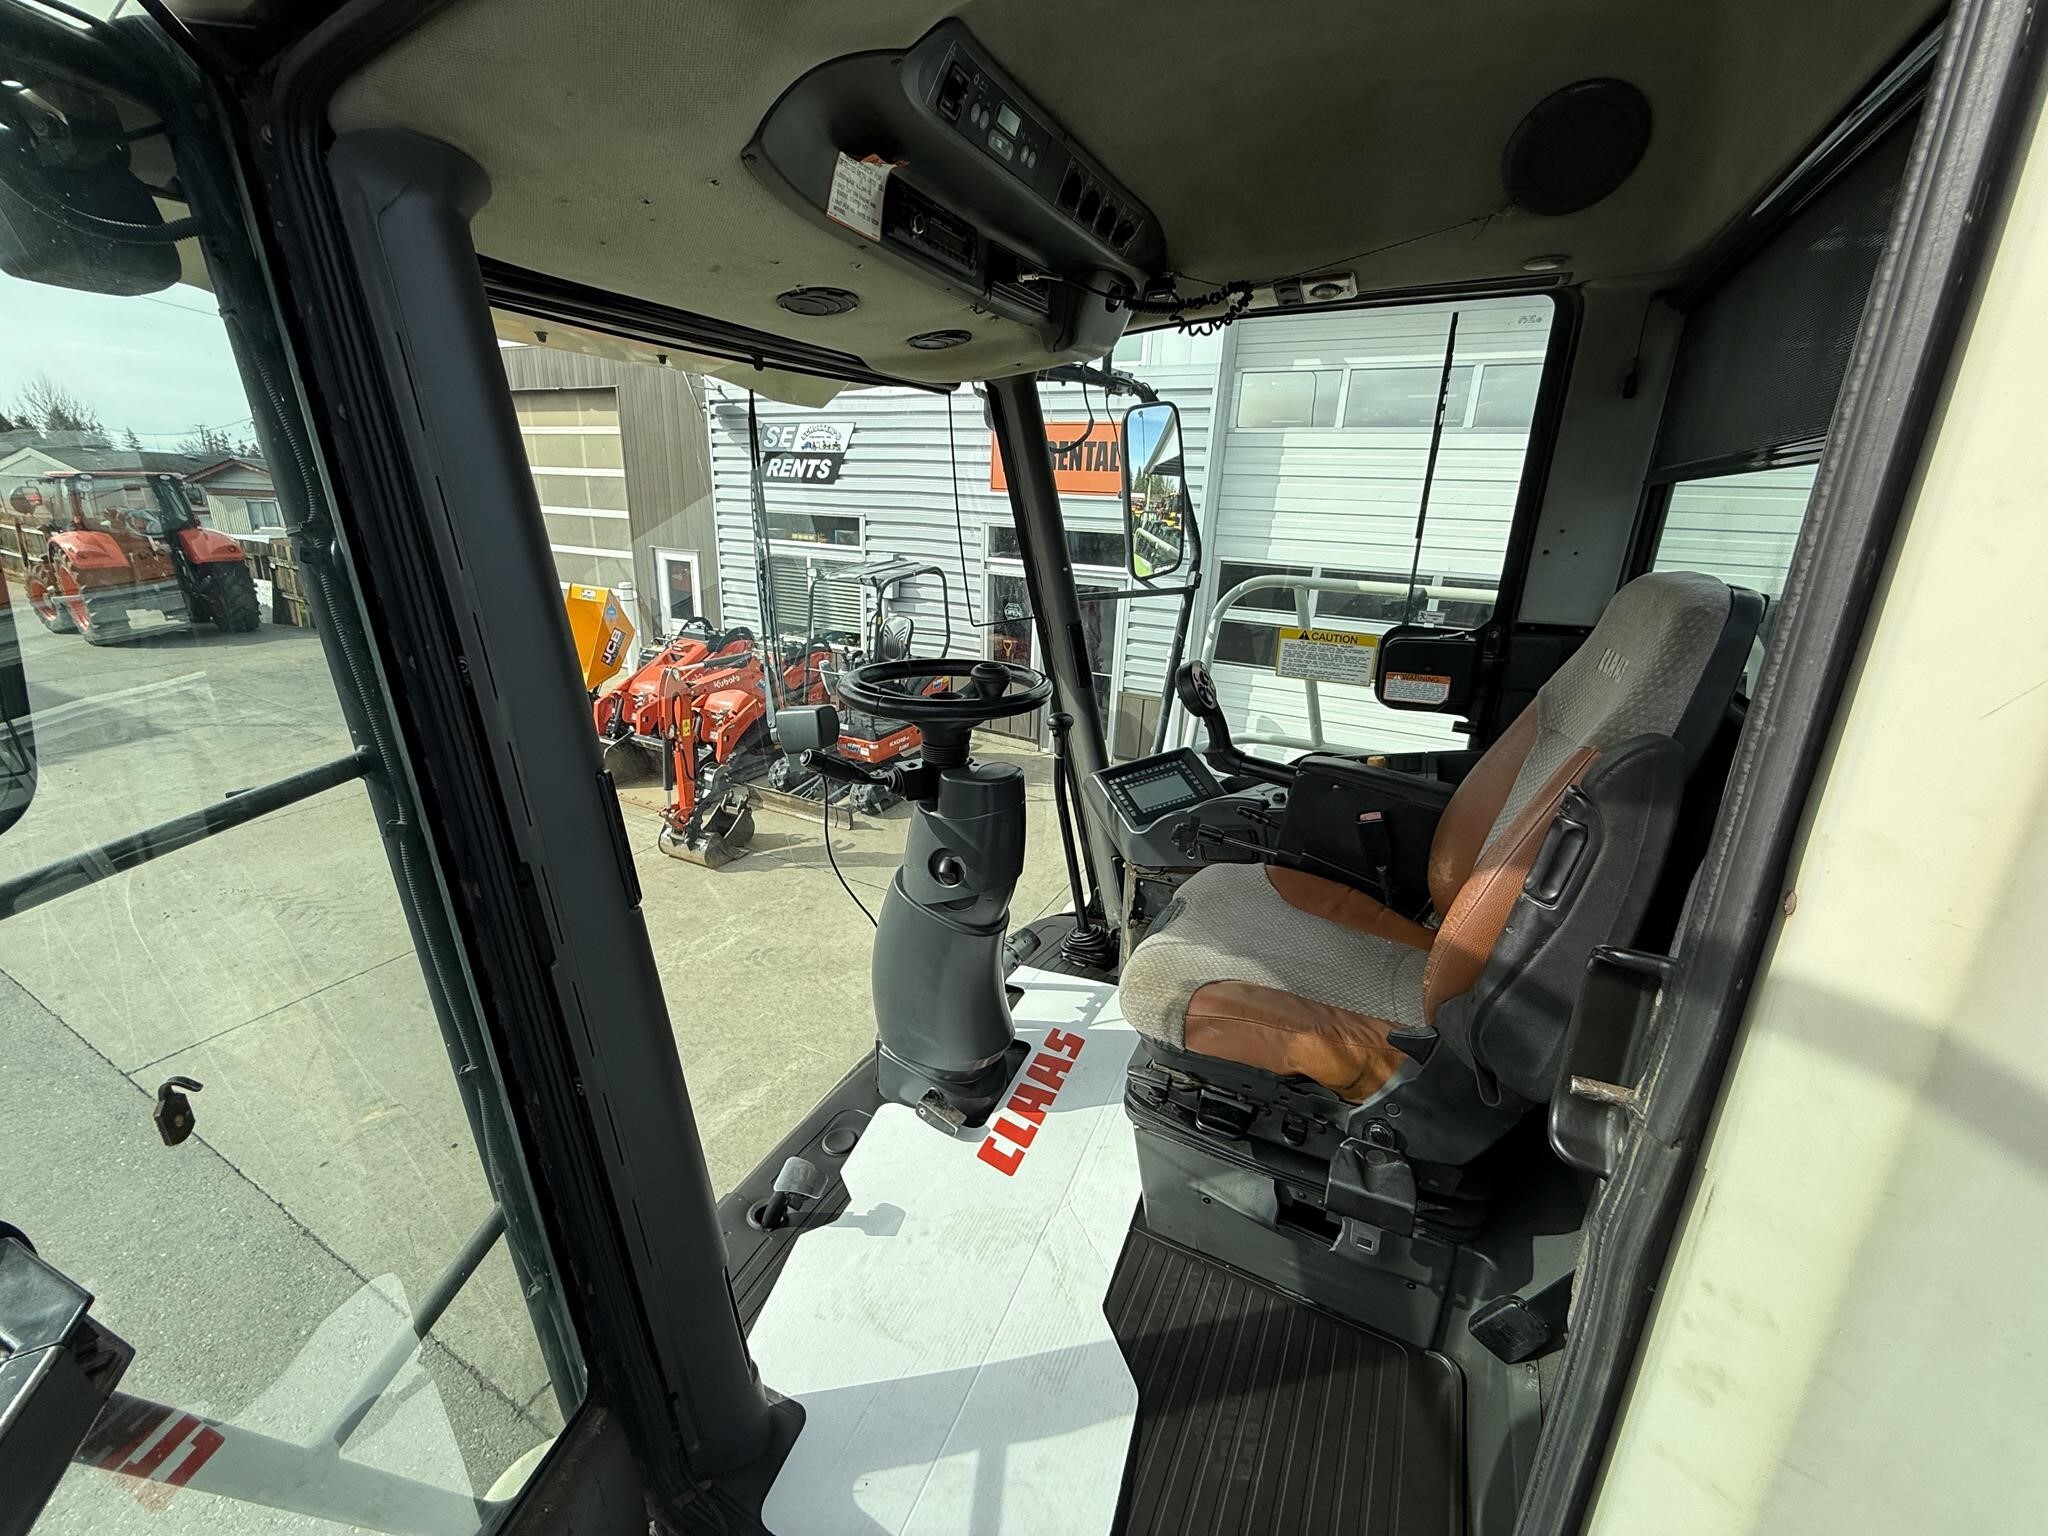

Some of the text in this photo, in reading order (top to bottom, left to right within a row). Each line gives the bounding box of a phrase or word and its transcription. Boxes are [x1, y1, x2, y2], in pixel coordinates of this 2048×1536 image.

[763, 425, 797, 448] SE
[1048, 440, 1120, 472] RENTAL
[766, 458, 833, 479] RENTS
[603, 628, 622, 664] JCB
[1311, 632, 1359, 644] CAUTION
[713, 674, 740, 689] Kubota
[1402, 674, 1440, 683] WARNING
[976, 1027, 1086, 1177] CLAAS
